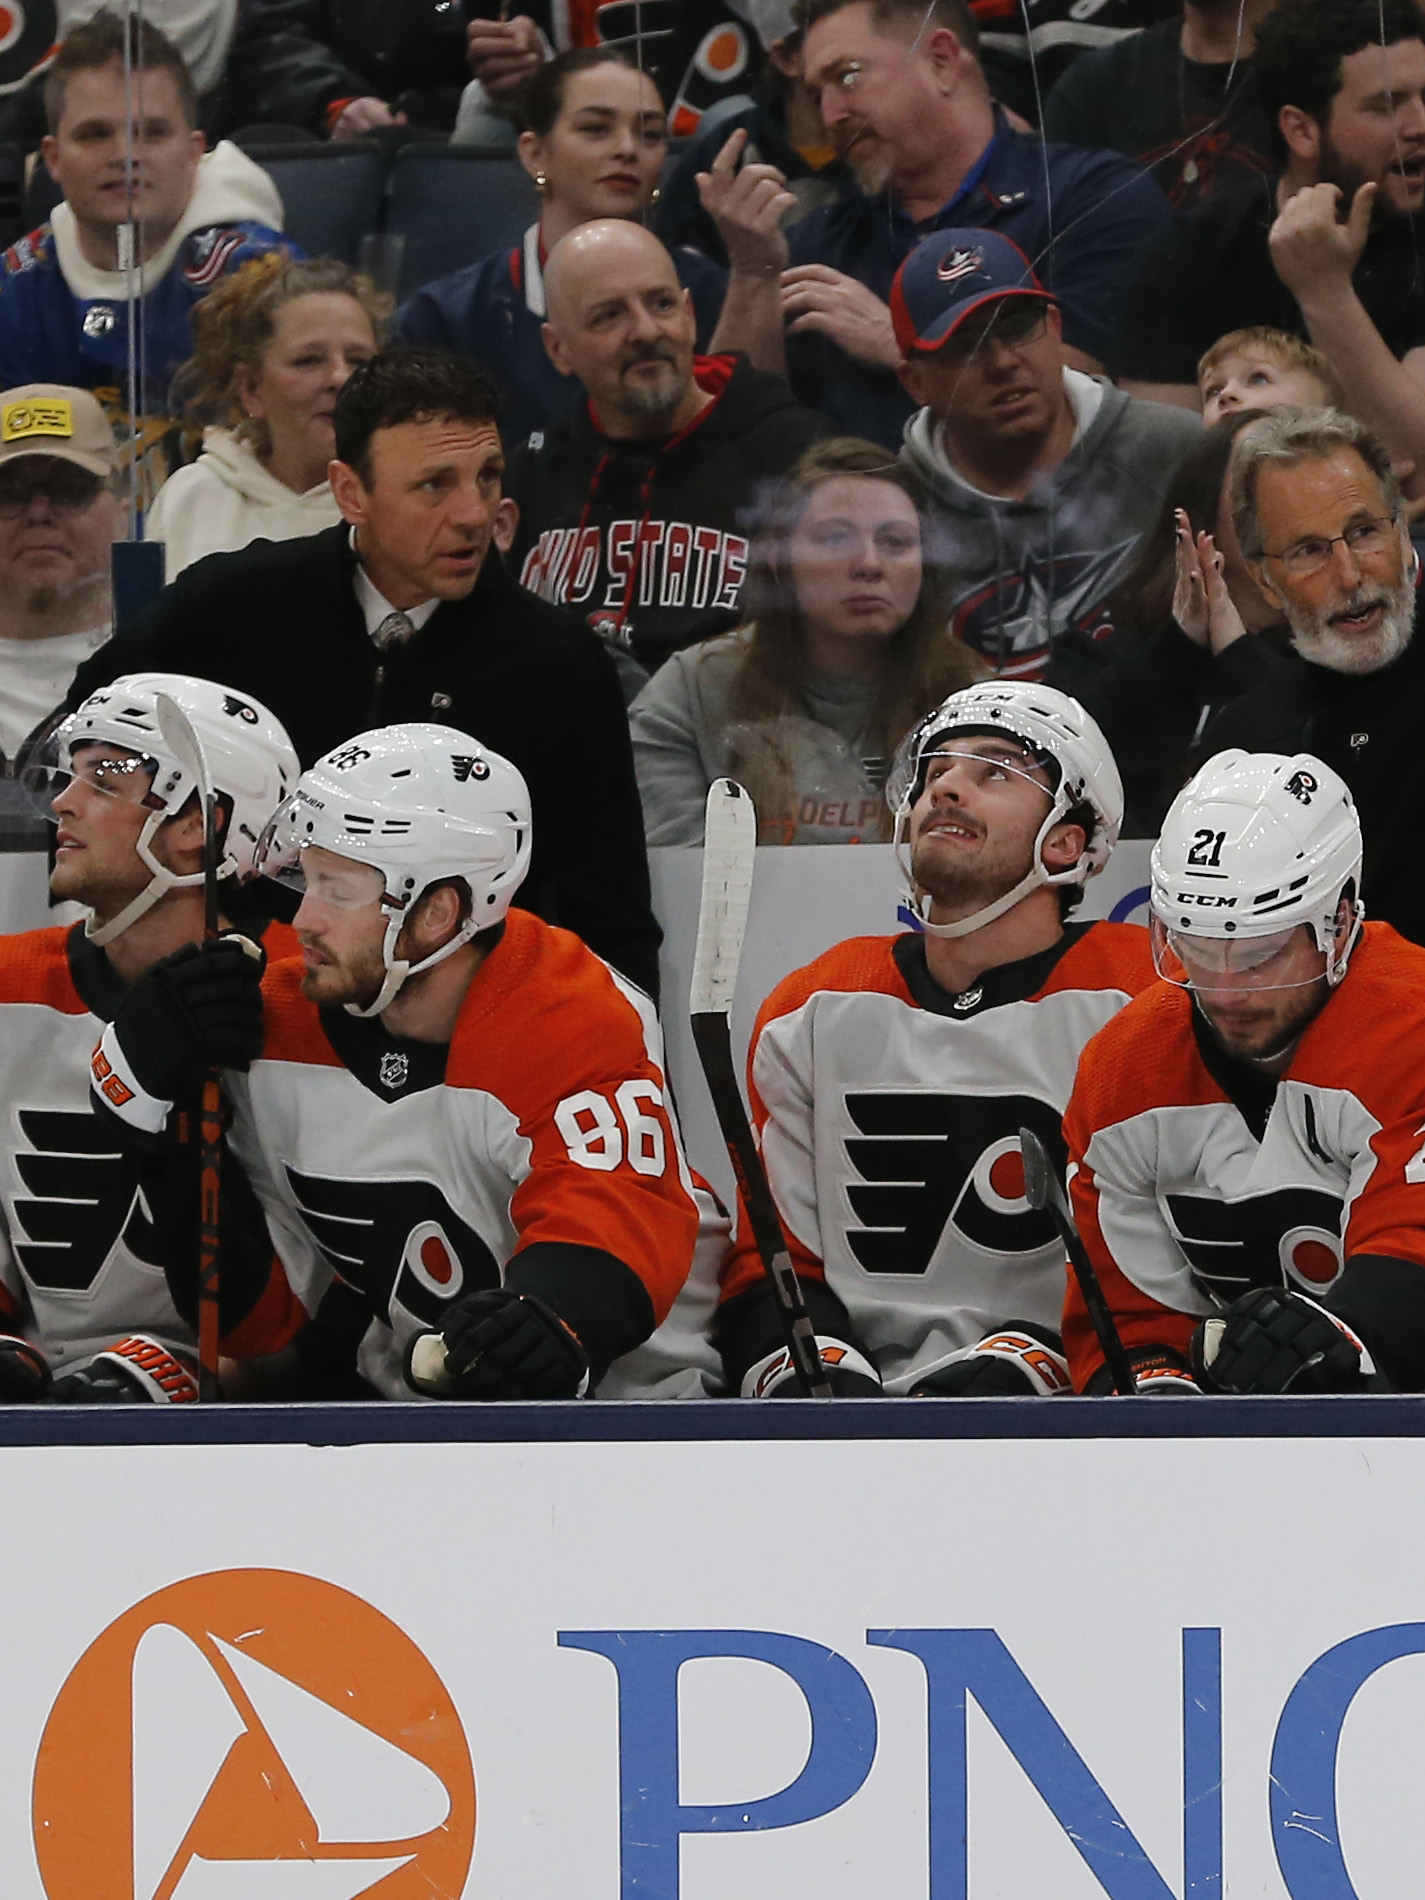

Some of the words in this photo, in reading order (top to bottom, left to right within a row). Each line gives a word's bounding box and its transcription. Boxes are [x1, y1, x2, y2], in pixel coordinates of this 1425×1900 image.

[603, 519, 749, 610] STATE
[1187, 828, 1227, 867] 21
[1177, 892, 1238, 908] CCM
[553, 1078, 666, 1178] 86
